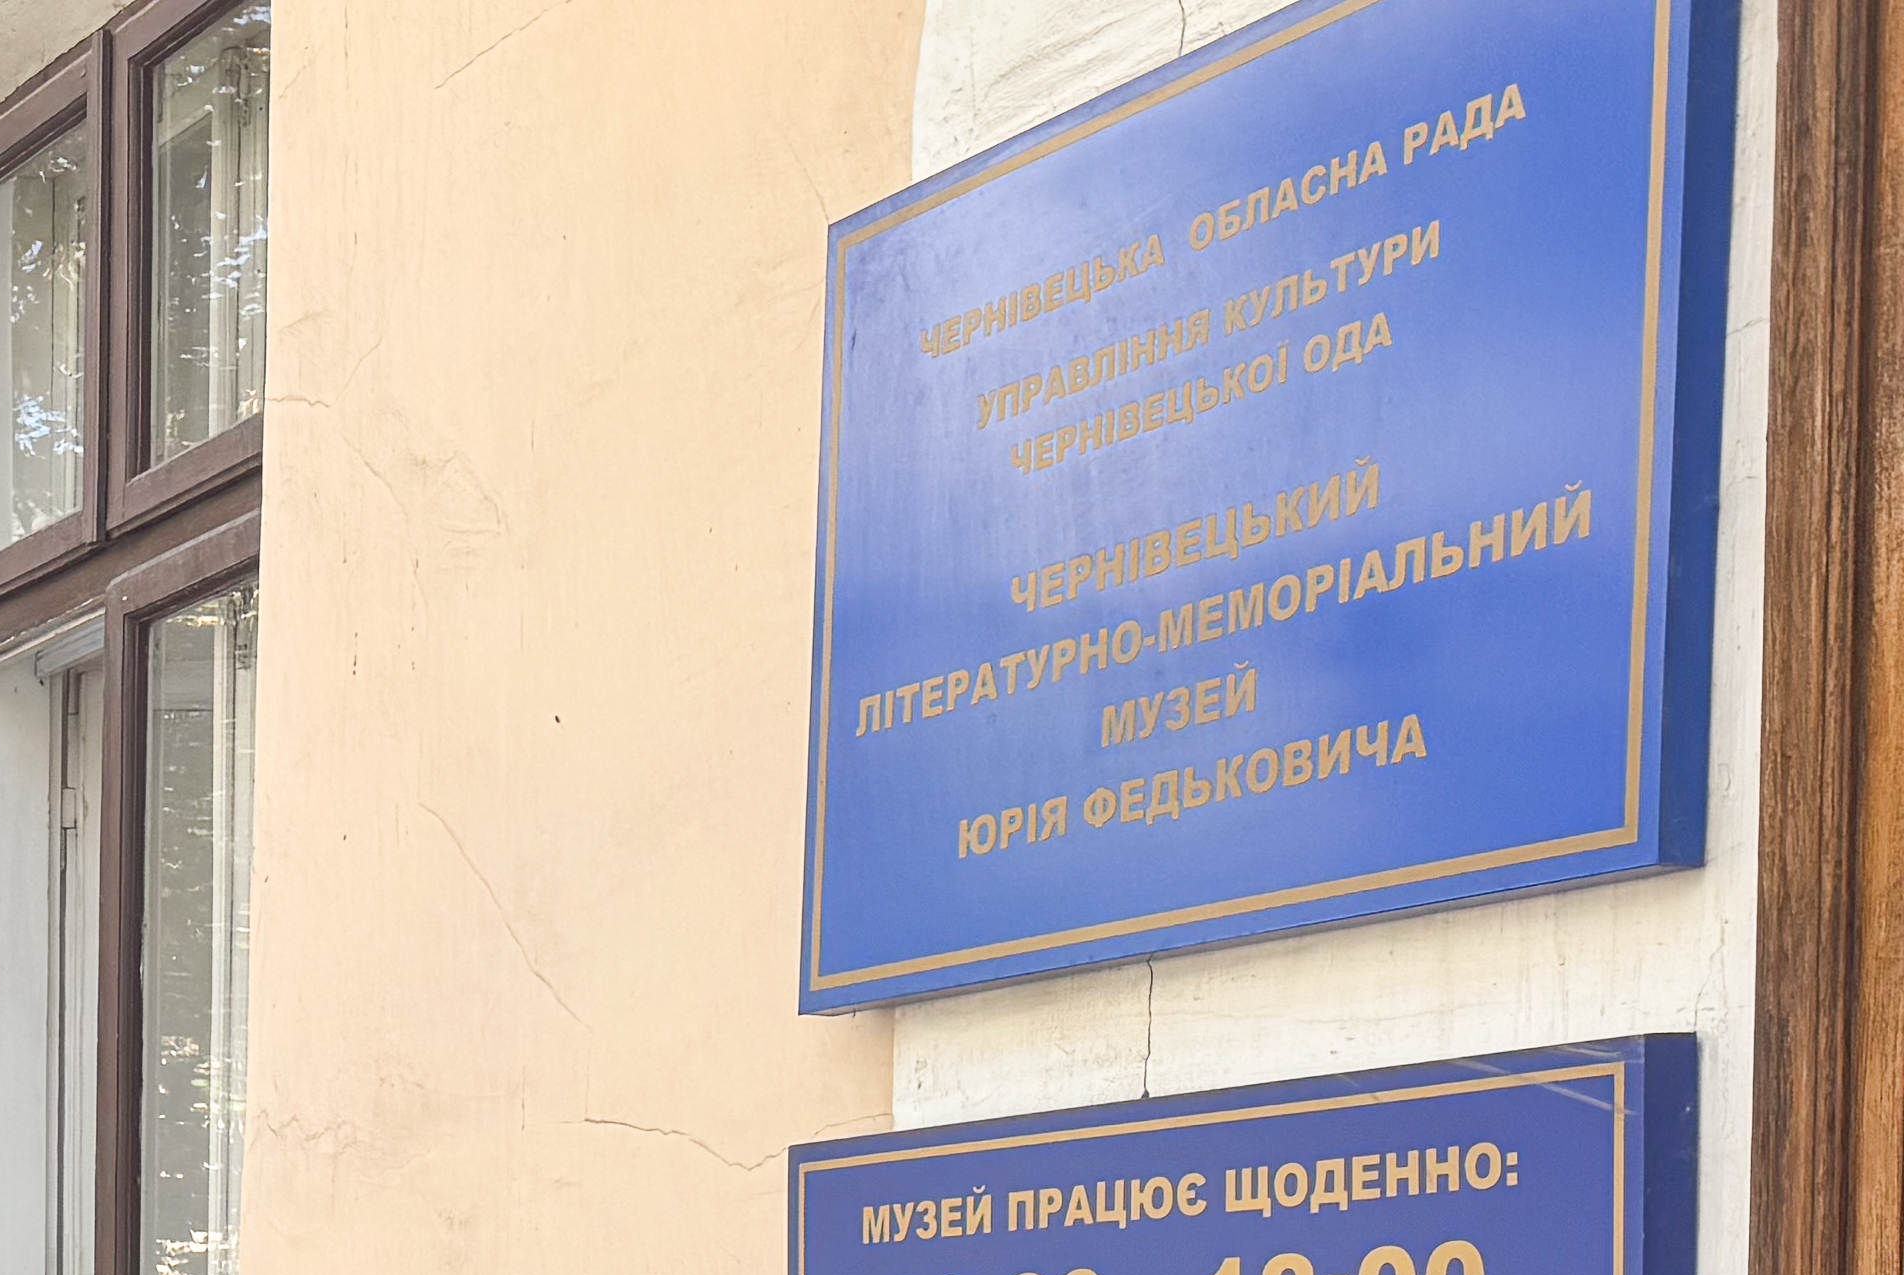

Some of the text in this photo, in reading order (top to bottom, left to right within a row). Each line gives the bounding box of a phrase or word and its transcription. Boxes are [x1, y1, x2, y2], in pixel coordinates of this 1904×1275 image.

[919, 83, 1527, 359] ЧЕРНІВЕЦЬКА ОБЛАСНА РАДА
[976, 220, 1442, 432] УПРАВЛІННЯ КУЛЬТУРИ
[1009, 312, 1394, 477] ЧЕРНІВЕЦЬКОЇ ОДА
[855, 483, 1594, 739] ЛІТЕРАТУРНО-МЕМОРІАЛЬНИЙ
[1010, 456, 1381, 615] ЧЕРНІВЕЦЬКИЙ
[957, 714, 1428, 860] ЮРІЯ ФЕДЬКОВИЧА
[1100, 662, 1259, 750] МУЗЕЙ
[861, 1141, 1520, 1247] МУЗЕЙ ПРАЦЮЄ ЩОДЕННО:
